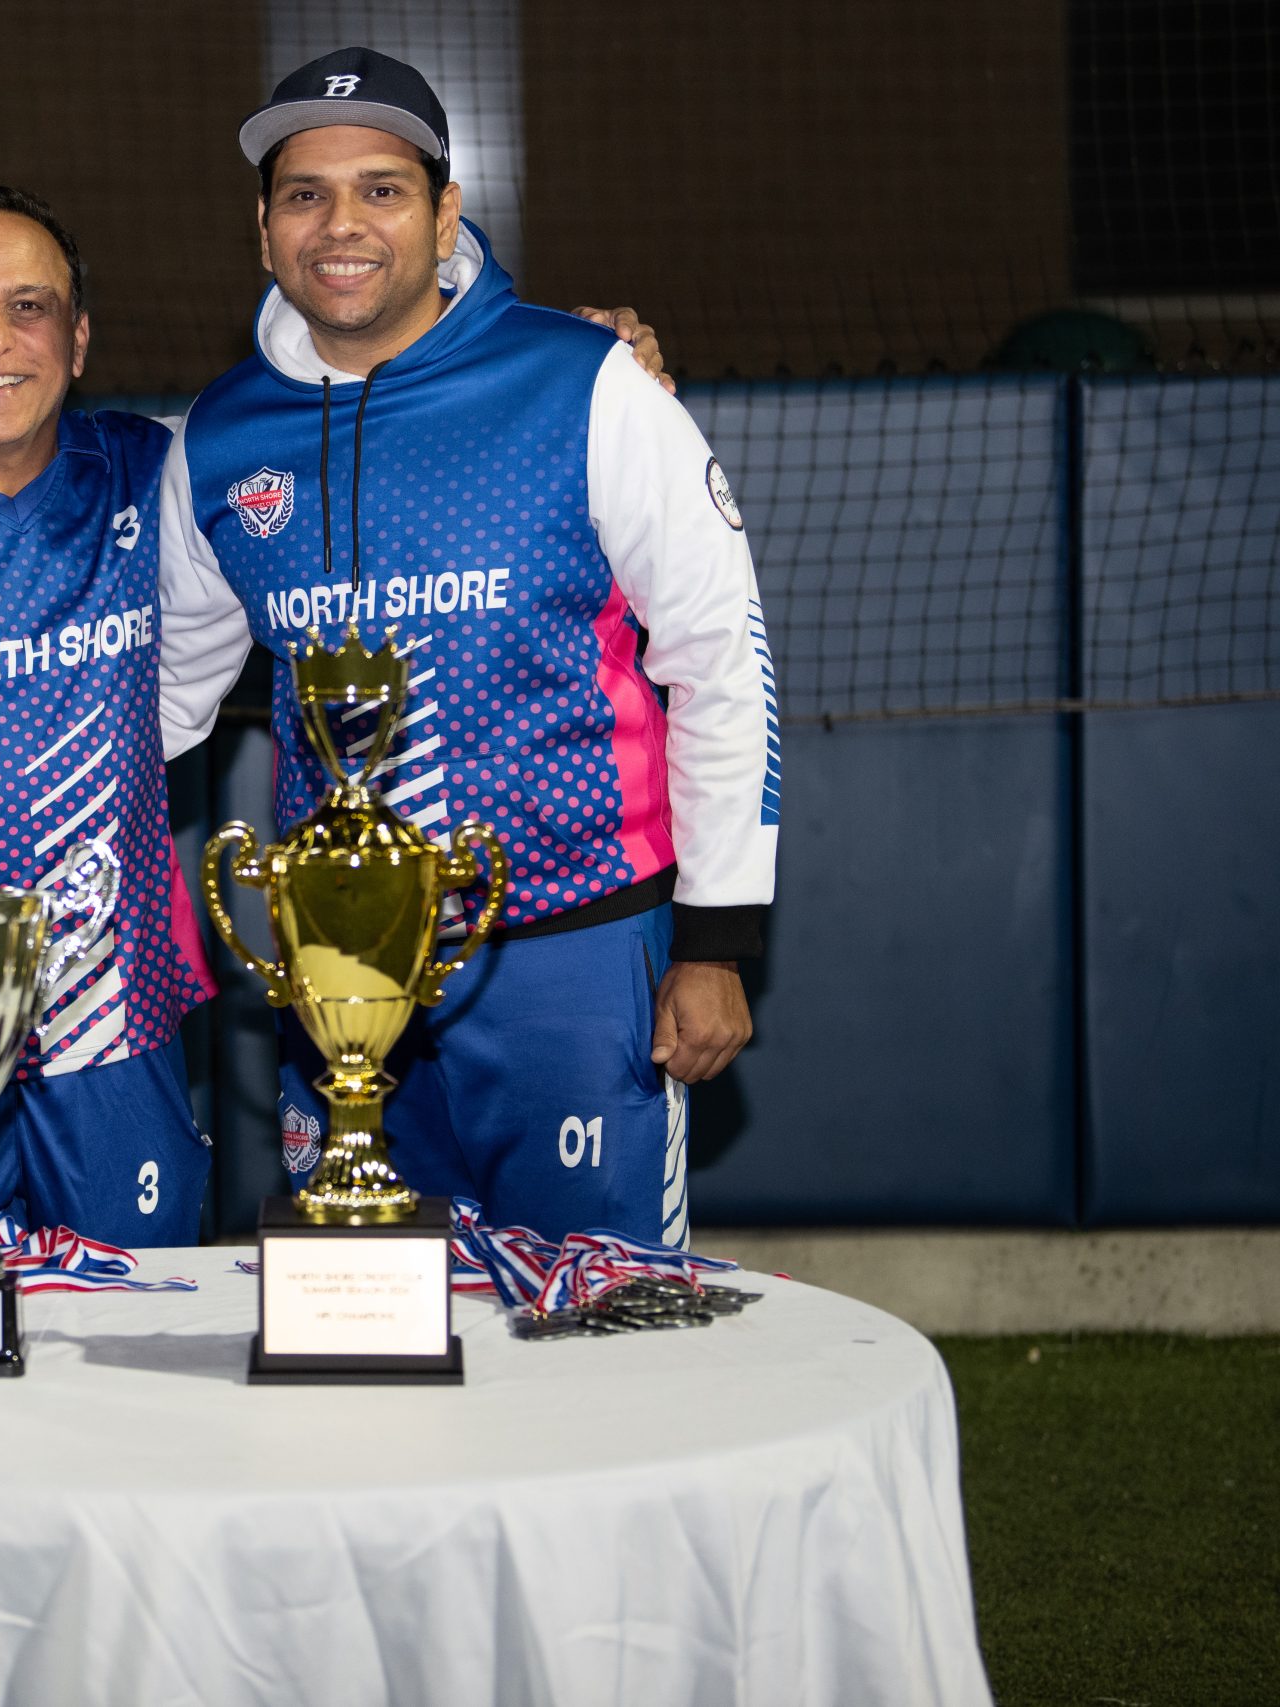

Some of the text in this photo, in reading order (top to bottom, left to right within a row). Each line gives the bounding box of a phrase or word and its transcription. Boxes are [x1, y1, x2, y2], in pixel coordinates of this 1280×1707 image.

[322, 75, 361, 96] B
[239, 491, 282, 505] NORTH SHORE
[113, 504, 141, 550] 3
[267, 567, 510, 630] NORTH SHORE
[58, 604, 153, 667] SHORE
[558, 1115, 603, 1168] 01
[137, 1160, 159, 1215] 3
